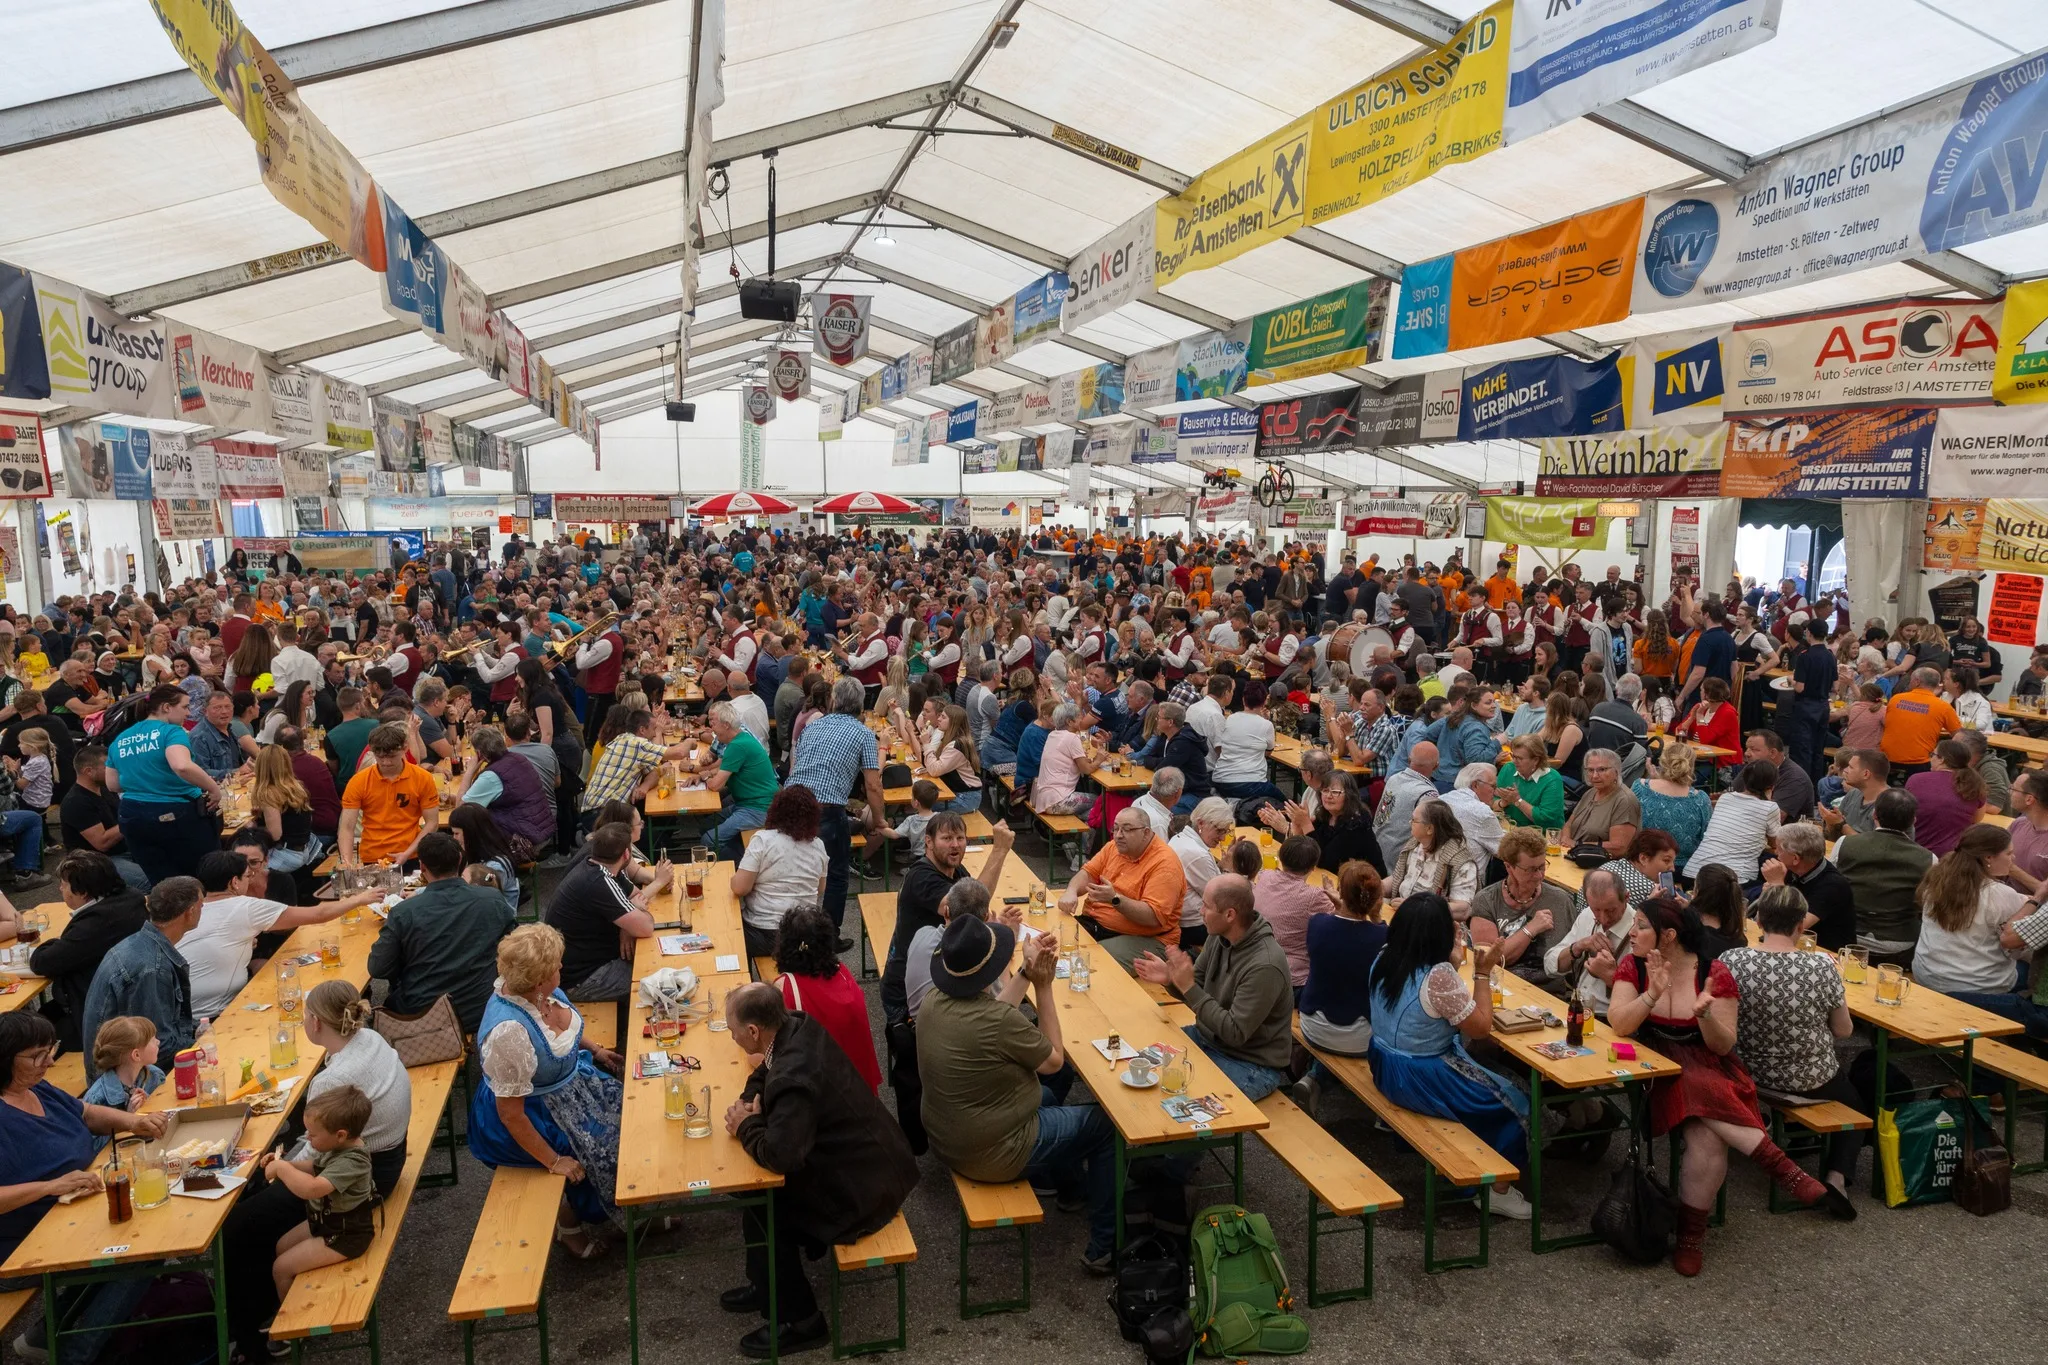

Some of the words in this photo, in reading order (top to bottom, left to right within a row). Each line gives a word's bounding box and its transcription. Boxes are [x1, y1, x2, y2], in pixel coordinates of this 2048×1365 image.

[1328, 78, 1407, 131] ULRICH
[1368, 118, 1390, 136] 3300
[1932, 145, 1962, 195] Anton
[1955, 85, 2002, 144] Wagner
[1999, 58, 2046, 93] Group
[1330, 137, 1381, 169] Lewingstraße
[1383, 135, 1395, 148] 2a
[1736, 184, 1776, 217] Anton
[1783, 165, 1845, 201] Wagner
[1851, 144, 1904, 179] Group
[1174, 165, 1266, 241] Raeisenbank
[1312, 193, 1361, 220] BRENNHOLZ
[1382, 172, 1410, 194] KOHLE
[1752, 207, 1793, 228] Spedition
[1794, 200, 1810, 213] und
[1813, 183, 1870, 209] Werkstätten
[1190, 210, 1263, 257] Amstetten
[1648, 230, 1659, 254] Anton
[1736, 244, 1783, 264] Amstetten
[1790, 238, 1800, 251] St.
[1802, 230, 1830, 247] Pölten
[1840, 217, 1880, 239] Zeltweg
[1704, 266, 1792, 296] www.wagnergroup.at
[1803, 235, 1909, 275] office@wagnergroup.at
[396, 280, 416, 300] Road
[1467, 255, 1624, 307] BERGER
[1412, 284, 1440, 302] GLASS
[824, 318, 856, 334] KAISER
[1264, 307, 1310, 354] LOIBL
[88, 356, 147, 399] group
[201, 355, 255, 391] Kerschner
[776, 367, 801, 379] KAISER
[1665, 360, 1710, 395] NV
[1814, 370, 1840, 381] Auto
[1843, 364, 1883, 379] Service
[1885, 360, 1924, 374] Center
[1927, 360, 1996, 374] Amstette
[1472, 373, 1507, 402] NÄHE
[1842, 384, 1894, 397] Feldstrasse
[1894, 383, 1904, 393] 13
[2016, 381, 2035, 391] Die
[1473, 380, 1548, 423] VERBINDET.
[1753, 394, 1773, 405] 0660
[1781, 393, 1790, 403] 19
[1792, 391, 1804, 402] 78
[1806, 390, 1821, 401] 041
[1183, 415, 1220, 429] Bauservice
[1223, 413, 1228, 426] &
[1261, 401, 1302, 437] CCS
[1404, 417, 1417, 429] 900
[1544, 455, 1568, 476] Die
[1568, 435, 1688, 476] Weinbar
[1891, 448, 1914, 459] IHR
[2001, 452, 2030, 460] Montage
[1801, 462, 1913, 475] ERSATZTEILPARTNER
[1552, 483, 1610, 494] Wein-Fachhandel
[1610, 482, 1631, 493] David
[1631, 482, 1664, 493] Bürscher
[1797, 478, 1815, 492] IN
[1816, 476, 1911, 491] AMSTETTEN
[1284, 516, 1297, 524] Bier
[1579, 523, 1590, 531] Eis
[243, 541, 290, 550] SPAR
[309, 541, 337, 549] Petra
[341, 540, 373, 549] HAHN
[1993, 540, 2019, 560] für
[247, 552, 272, 560] IREKT
[120, 747, 134, 758] BA
[136, 739, 160, 755] MIA!
[1938, 1134, 1957, 1147] Die
[1934, 1147, 1963, 1162] Kraft
[1932, 1175, 1953, 1188] Lan
